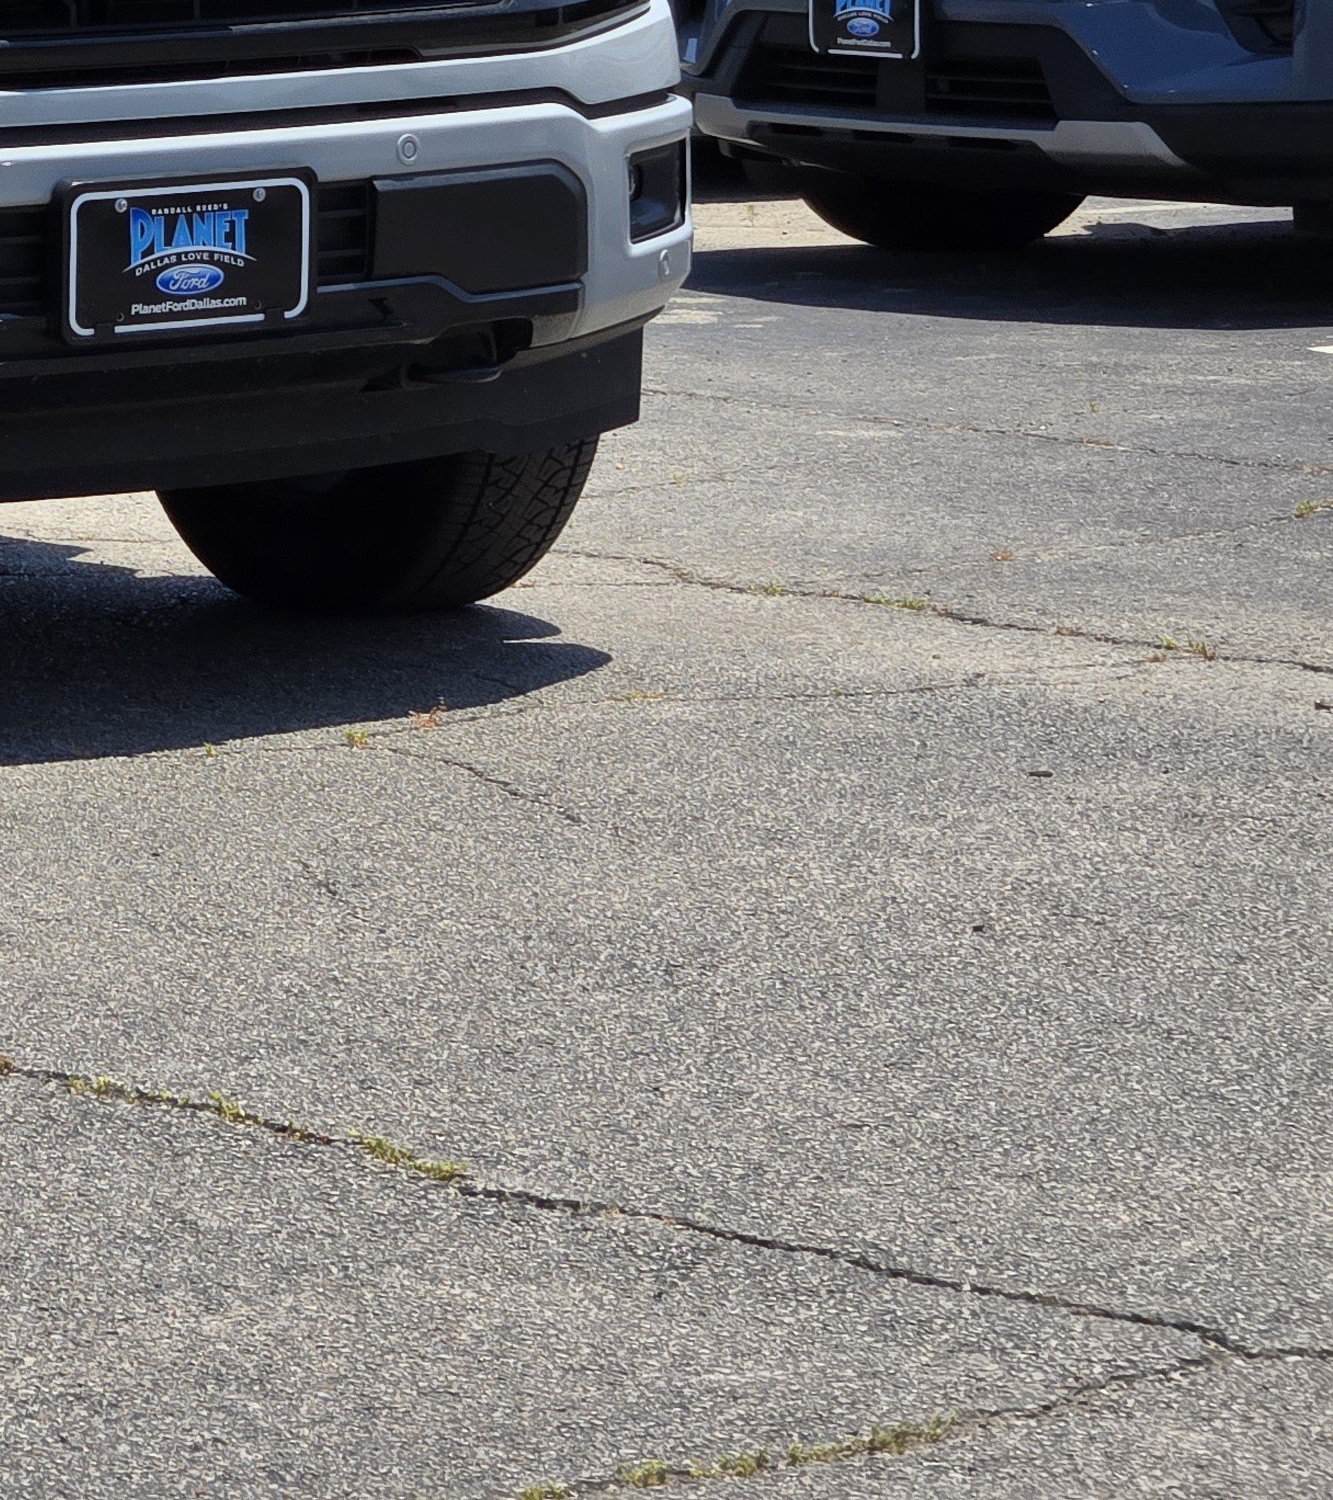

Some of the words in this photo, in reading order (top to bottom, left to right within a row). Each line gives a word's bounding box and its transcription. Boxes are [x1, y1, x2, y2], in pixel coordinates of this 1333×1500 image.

[129, 206, 249, 266] PLANET
[135, 254, 177, 277] DALLAS
[181, 251, 210, 262] LOVE
[213, 252, 245, 267] FIELD
[168, 270, 211, 292] Ford
[130, 296, 247, 316] PlanetFordDallas.com
